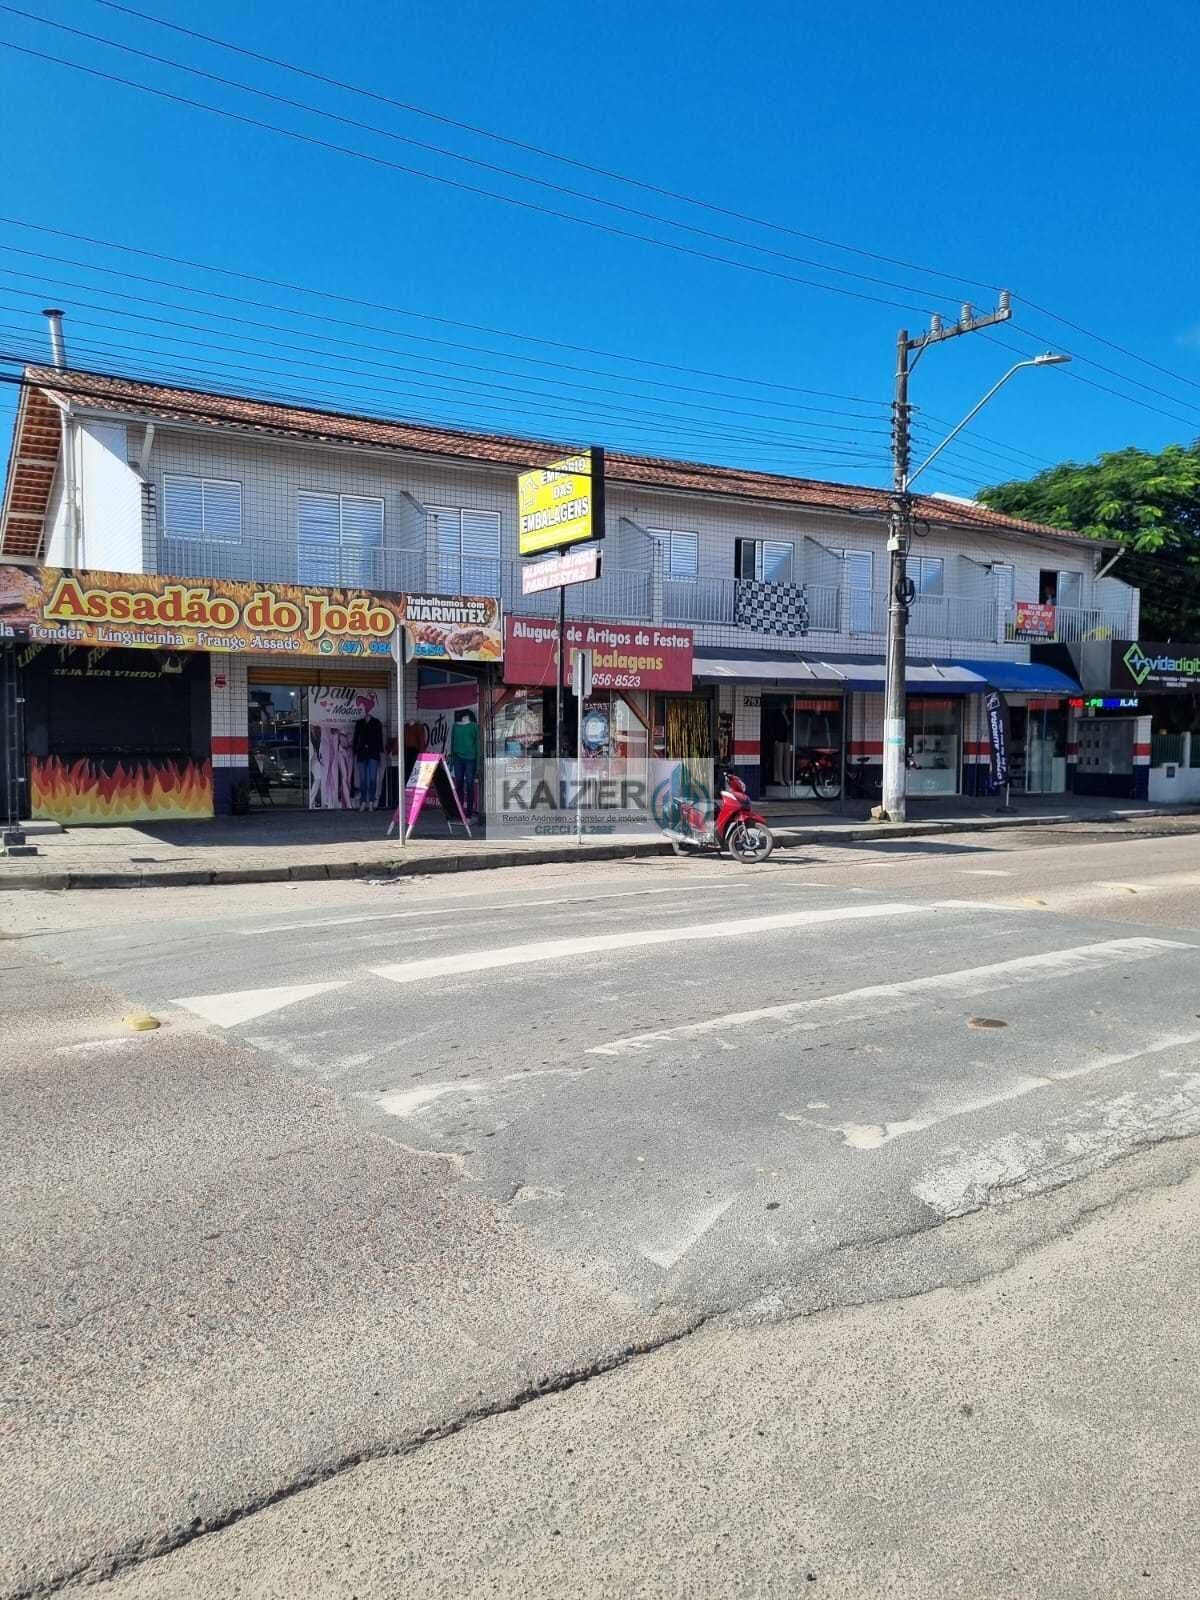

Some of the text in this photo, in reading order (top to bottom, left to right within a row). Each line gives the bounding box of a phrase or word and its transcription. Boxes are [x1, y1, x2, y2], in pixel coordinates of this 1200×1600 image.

[553, 481, 573, 500] DAS
[520, 496, 589, 534] EMBALAGENS
[44, 578, 397, 640] Assadão do João
[406, 605, 486, 624] MARMITEX
[407, 595, 485, 609] Trabalhamos com
[29, 624, 83, 641] Tender
[97, 627, 184, 646] Linguicinha
[198, 633, 246, 649] Frango
[250, 636, 300, 650] Assado
[513, 622, 690, 648] Alugue de Artigos de Festas
[569, 647, 664, 674] balagens
